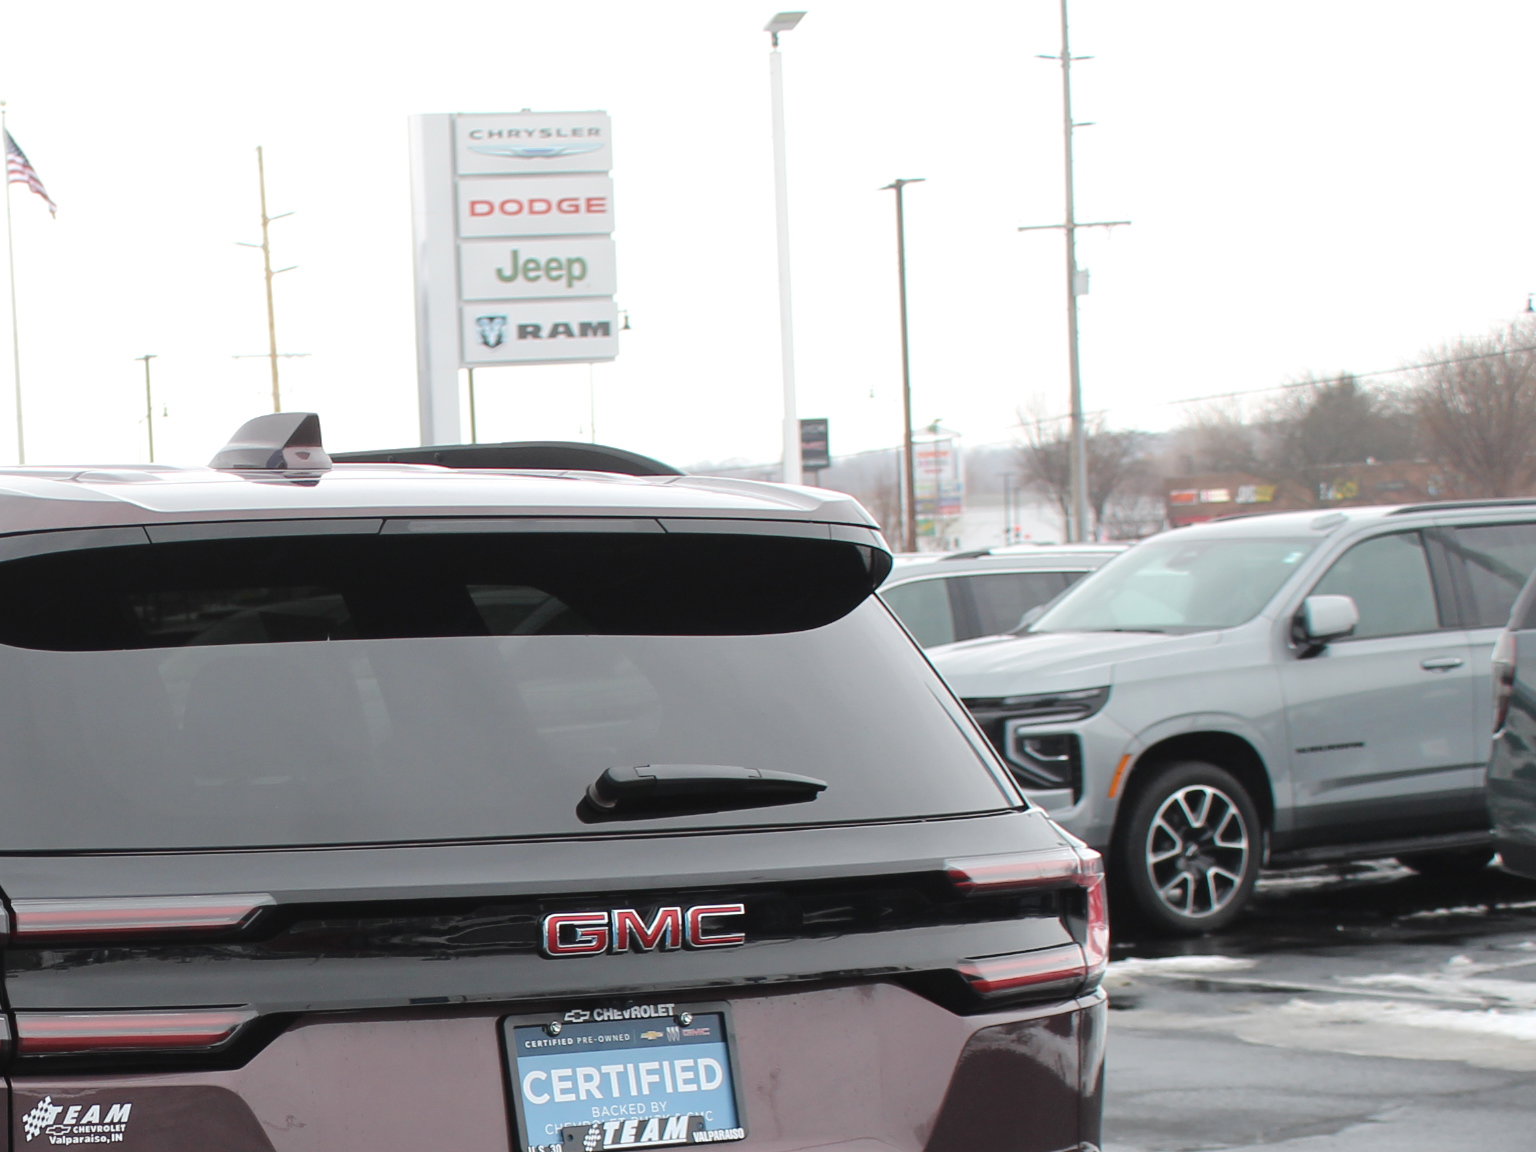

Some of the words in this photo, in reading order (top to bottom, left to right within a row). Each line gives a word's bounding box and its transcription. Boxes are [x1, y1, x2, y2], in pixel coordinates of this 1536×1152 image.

[469, 127, 601, 140] CHRYSLER
[469, 197, 607, 217] DODGE
[495, 249, 587, 288] Jeep
[516, 321, 611, 340] RAM
[543, 903, 746, 956] GMC
[593, 1003, 675, 1022] CHEVROLET
[524, 1037, 574, 1048] CERTIFIED
[576, 1033, 631, 1045] PRE-OWNED
[523, 1057, 724, 1105] CERTIFIED
[47, 1103, 132, 1125] TEAM
[591, 1103, 646, 1118] BACKED
[651, 1101, 668, 1113] BY
[72, 1124, 126, 1134] CHEVROLET
[602, 1115, 689, 1146] TEAM
[692, 1128, 745, 1143] VALPARAISO
